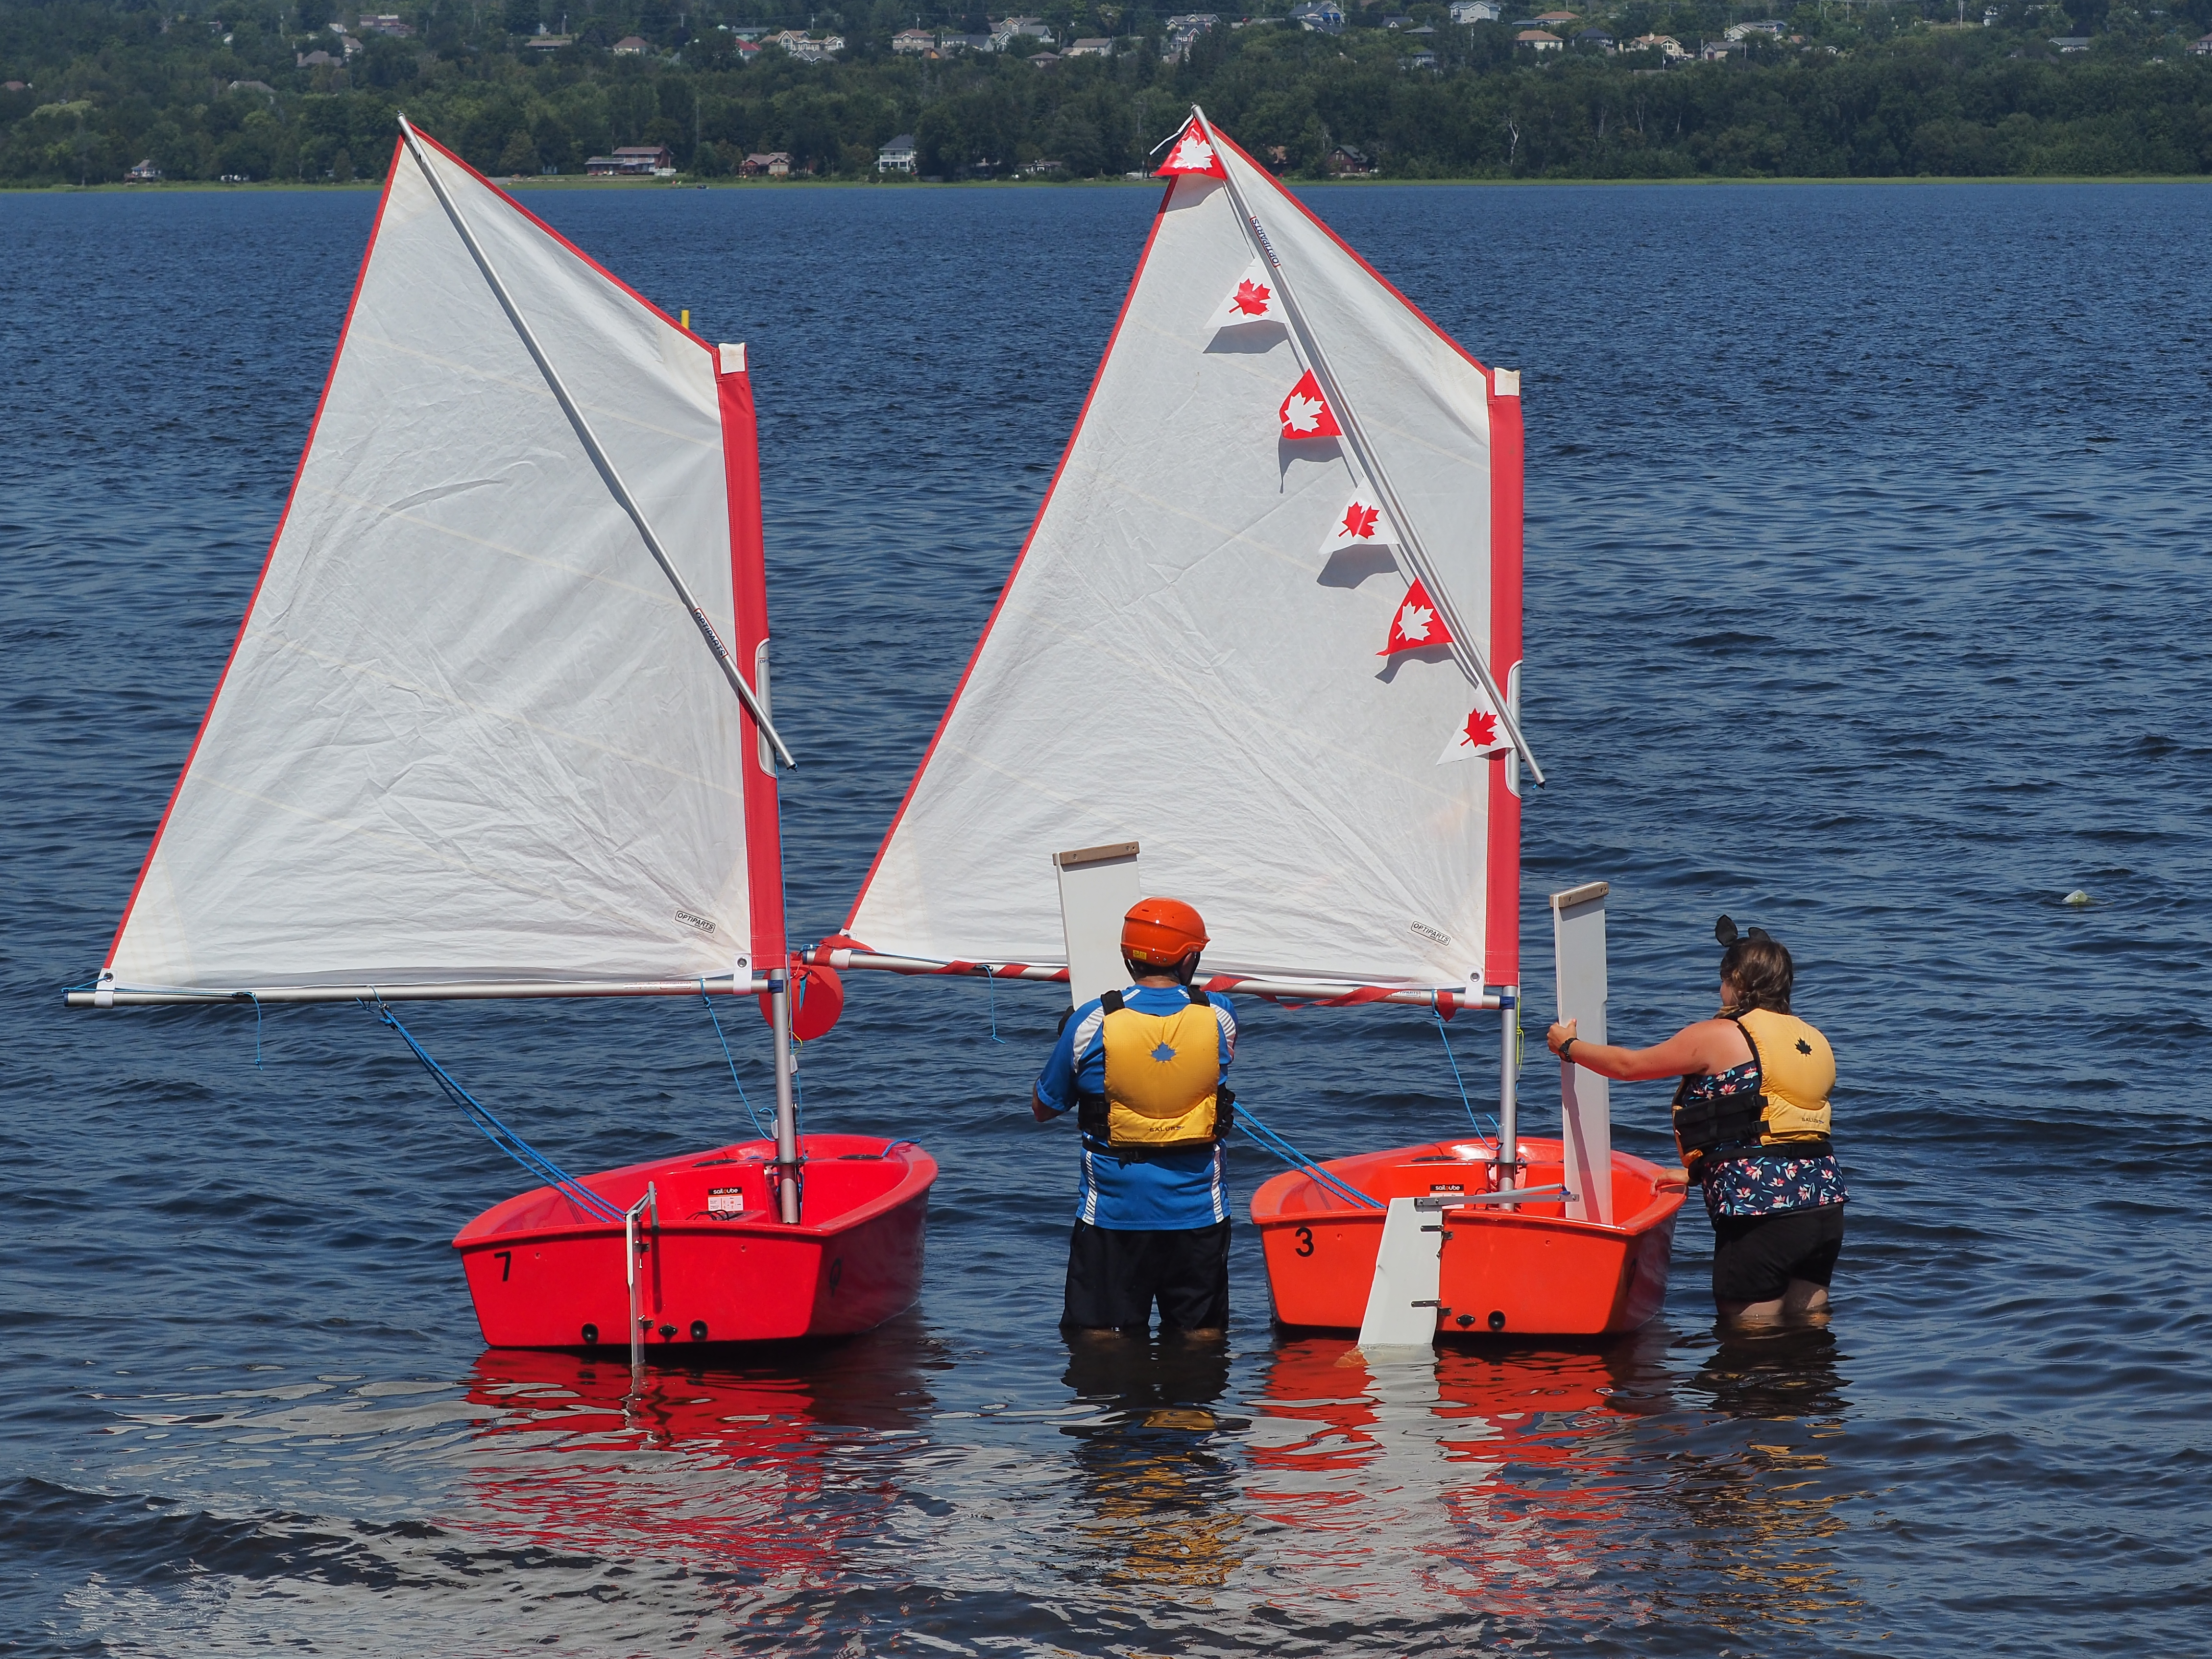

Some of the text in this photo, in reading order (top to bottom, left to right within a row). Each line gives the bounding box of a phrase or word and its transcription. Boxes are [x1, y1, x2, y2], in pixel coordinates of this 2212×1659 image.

[1252, 219, 1279, 264] OPTIPARTS
[696, 612, 725, 656] OPTIPARTS
[677, 913, 714, 929] OPTIPARTS
[1414, 924, 1449, 942] OPTIPARTS
[1295, 1227, 1314, 1257] 3
[494, 1251, 511, 1282] 7
